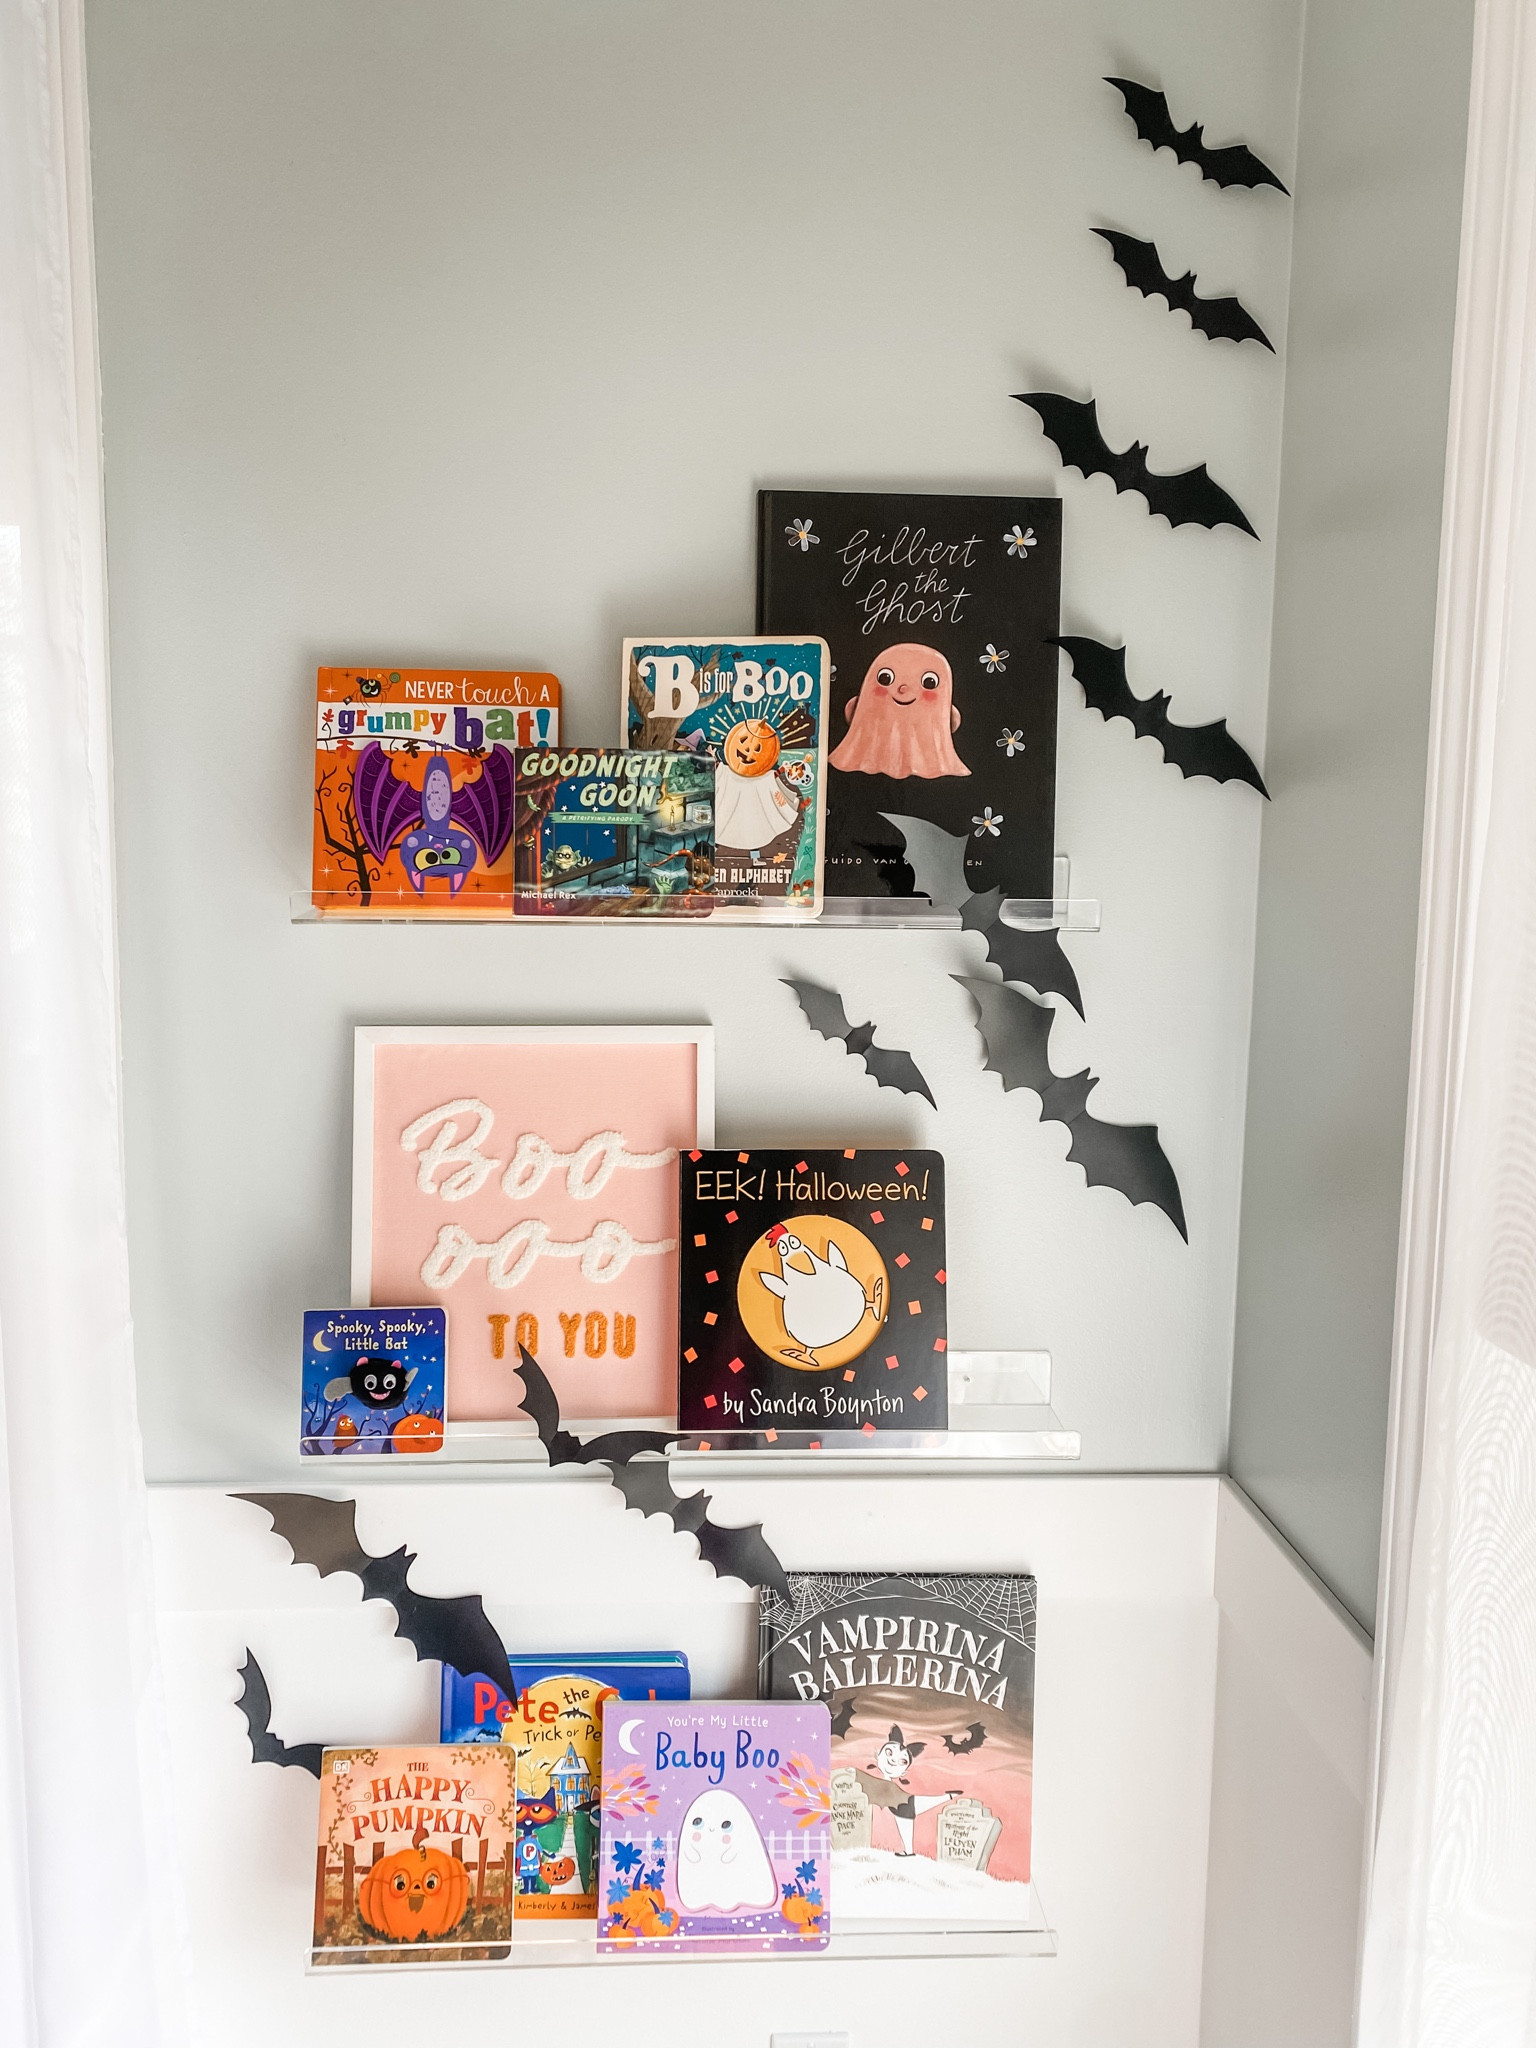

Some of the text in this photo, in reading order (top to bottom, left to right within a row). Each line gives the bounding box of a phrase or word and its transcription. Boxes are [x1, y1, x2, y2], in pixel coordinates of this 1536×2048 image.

[835, 524, 985, 586] Gilbert
[914, 568, 950, 593] the
[856, 578, 974, 635] Ghost
[405, 676, 550, 705] NEVER touch A
[638, 655, 699, 719] B
[714, 668, 733, 693] for
[338, 706, 551, 748] grumpy bat!
[521, 752, 678, 778] GOODNIGHT
[580, 782, 657, 807] GOON
[730, 868, 792, 884] ALPHABET
[521, 890, 557, 899] Michael
[399, 1097, 677, 1202] Boo
[696, 1169, 930, 1202] EEK! Halloween!
[327, 1319, 426, 1338] Spooky, Spooky,
[345, 1337, 408, 1351] Little Bat
[488, 1311, 636, 1360] TO YOU
[723, 1387, 904, 1424] by Sandra Boynton
[788, 1614, 1007, 1675] VAMPIRINA
[789, 1654, 1009, 1711] BALLERINA
[474, 1682, 559, 1725] Pete
[563, 1687, 590, 1705] the
[523, 1724, 562, 1745] Trick
[566, 1728, 579, 1738] or
[667, 1715, 769, 1729] You're My Little
[407, 1762, 429, 1772] THE
[656, 1729, 780, 1785] Baby Boo
[370, 1774, 471, 1804] HAPPY
[350, 1805, 487, 1841] PUMPKIN
[518, 1901, 556, 1911] Kimberly
[561, 1901, 567, 1910] &
